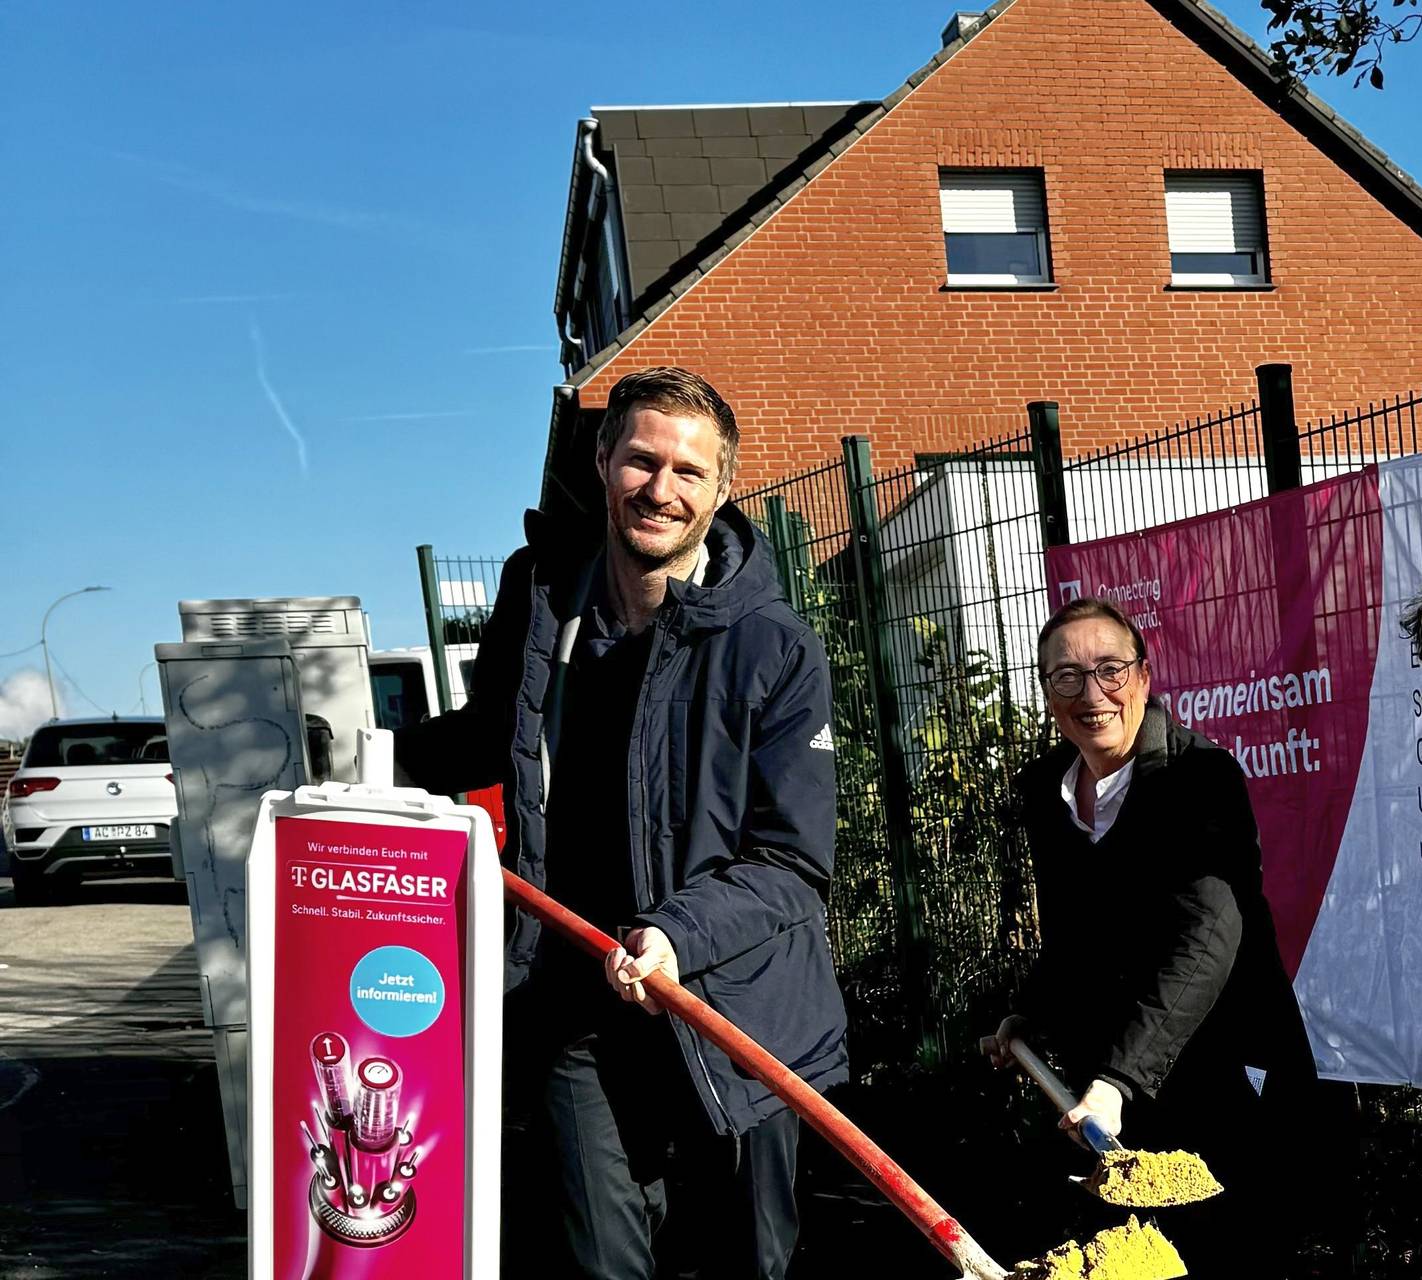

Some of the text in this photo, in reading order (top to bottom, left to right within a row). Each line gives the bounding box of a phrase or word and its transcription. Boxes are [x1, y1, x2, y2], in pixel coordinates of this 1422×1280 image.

[1098, 576, 1161, 601] Connecting
[1177, 667, 1332, 729] gemeinsam
[1229, 727, 1320, 779] kunft:
[308, 842, 428, 860] Wir verbinden Euch mit
[311, 868, 447, 898] GLASFASER
[291, 904, 446, 925] Schnell. Stabil. Zukunftssicher.
[379, 972, 414, 987] Jetzt
[357, 986, 437, 1004] informieren!
